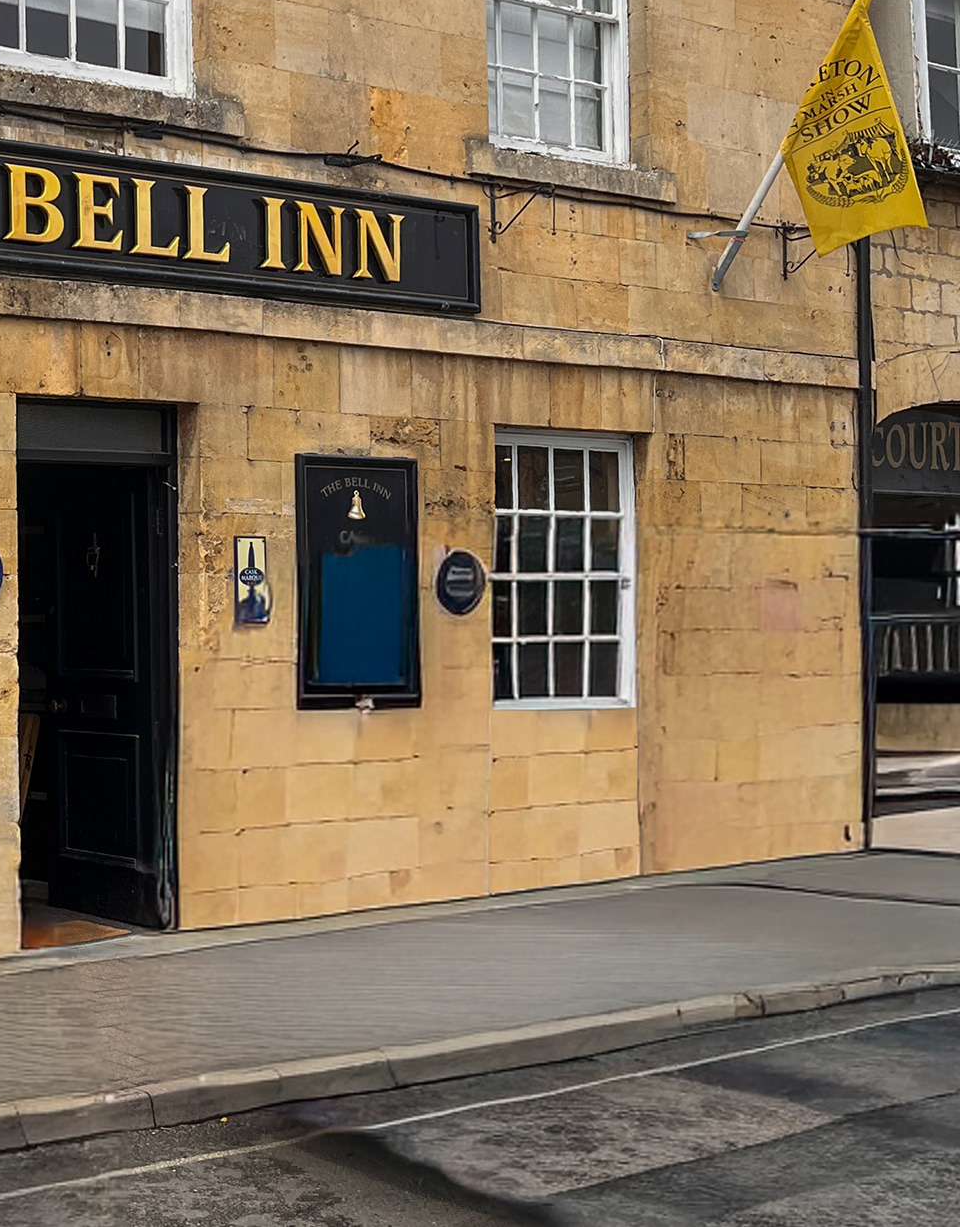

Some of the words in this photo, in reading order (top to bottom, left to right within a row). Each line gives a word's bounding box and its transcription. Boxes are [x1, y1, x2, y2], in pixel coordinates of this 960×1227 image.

[801, 83, 859, 121] MARSH
[820, 88, 835, 102] IN
[800, 93, 872, 144] SHOW
[2, 162, 231, 264] BELL
[260, 196, 406, 283] INN
[320, 479, 343, 498] THE
[344, 477, 371, 489] BELL
[372, 482, 392, 500] INN
